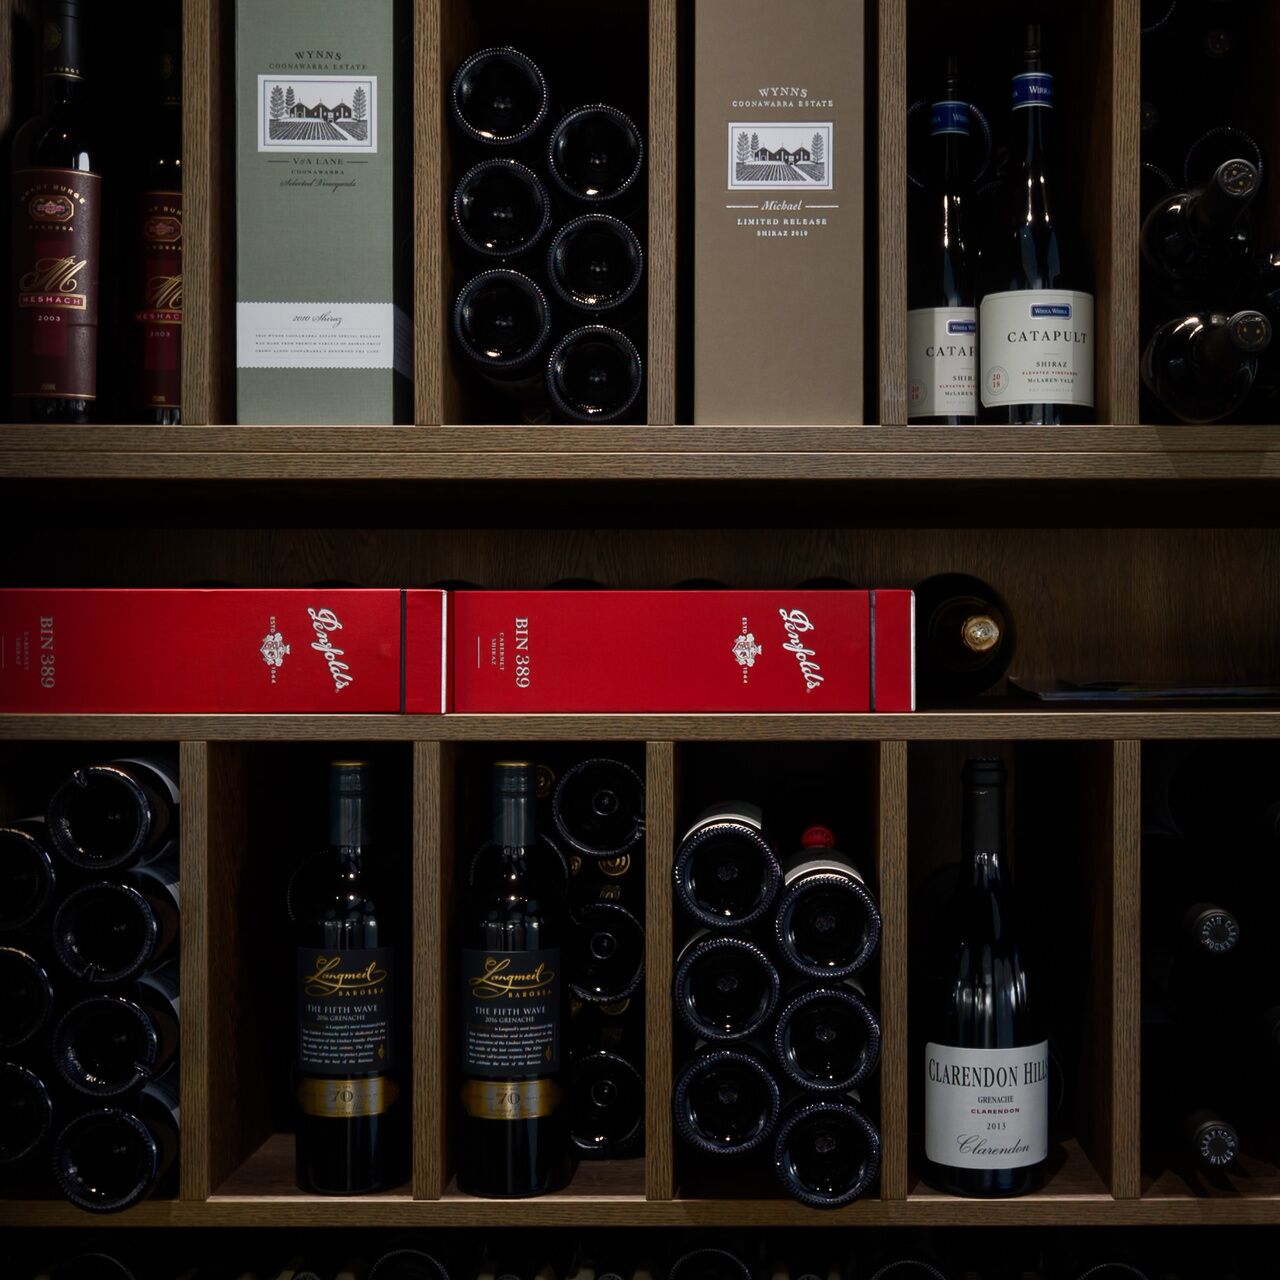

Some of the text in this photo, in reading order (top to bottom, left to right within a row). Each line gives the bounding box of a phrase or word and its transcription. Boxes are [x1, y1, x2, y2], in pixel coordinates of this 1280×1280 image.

[295, 50, 342, 60] WYNNS
[758, 87, 808, 98] WYNNS
[761, 200, 803, 211] Michael
[1007, 331, 1088, 344] CATAPULT
[40, 615, 55, 689] BIN 389
[307, 607, 353, 690] Penfolds
[515, 616, 530, 689] BIN 389
[779, 608, 825, 690] Penfolds
[304, 956, 388, 997] Langmeil
[469, 958, 556, 999] Langmeil
[338, 988, 384, 997] BAROSSA
[508, 988, 553, 999] BAROSSA
[307, 1004, 377, 1014] THE FIFTH WAVE
[474, 1005, 545, 1016] THE FIFTH WAVE
[928, 1058, 1018, 1088] CLARENDON
[977, 1096, 1014, 1104] GRENACHE
[956, 1134, 1030, 1155] Clarendon
